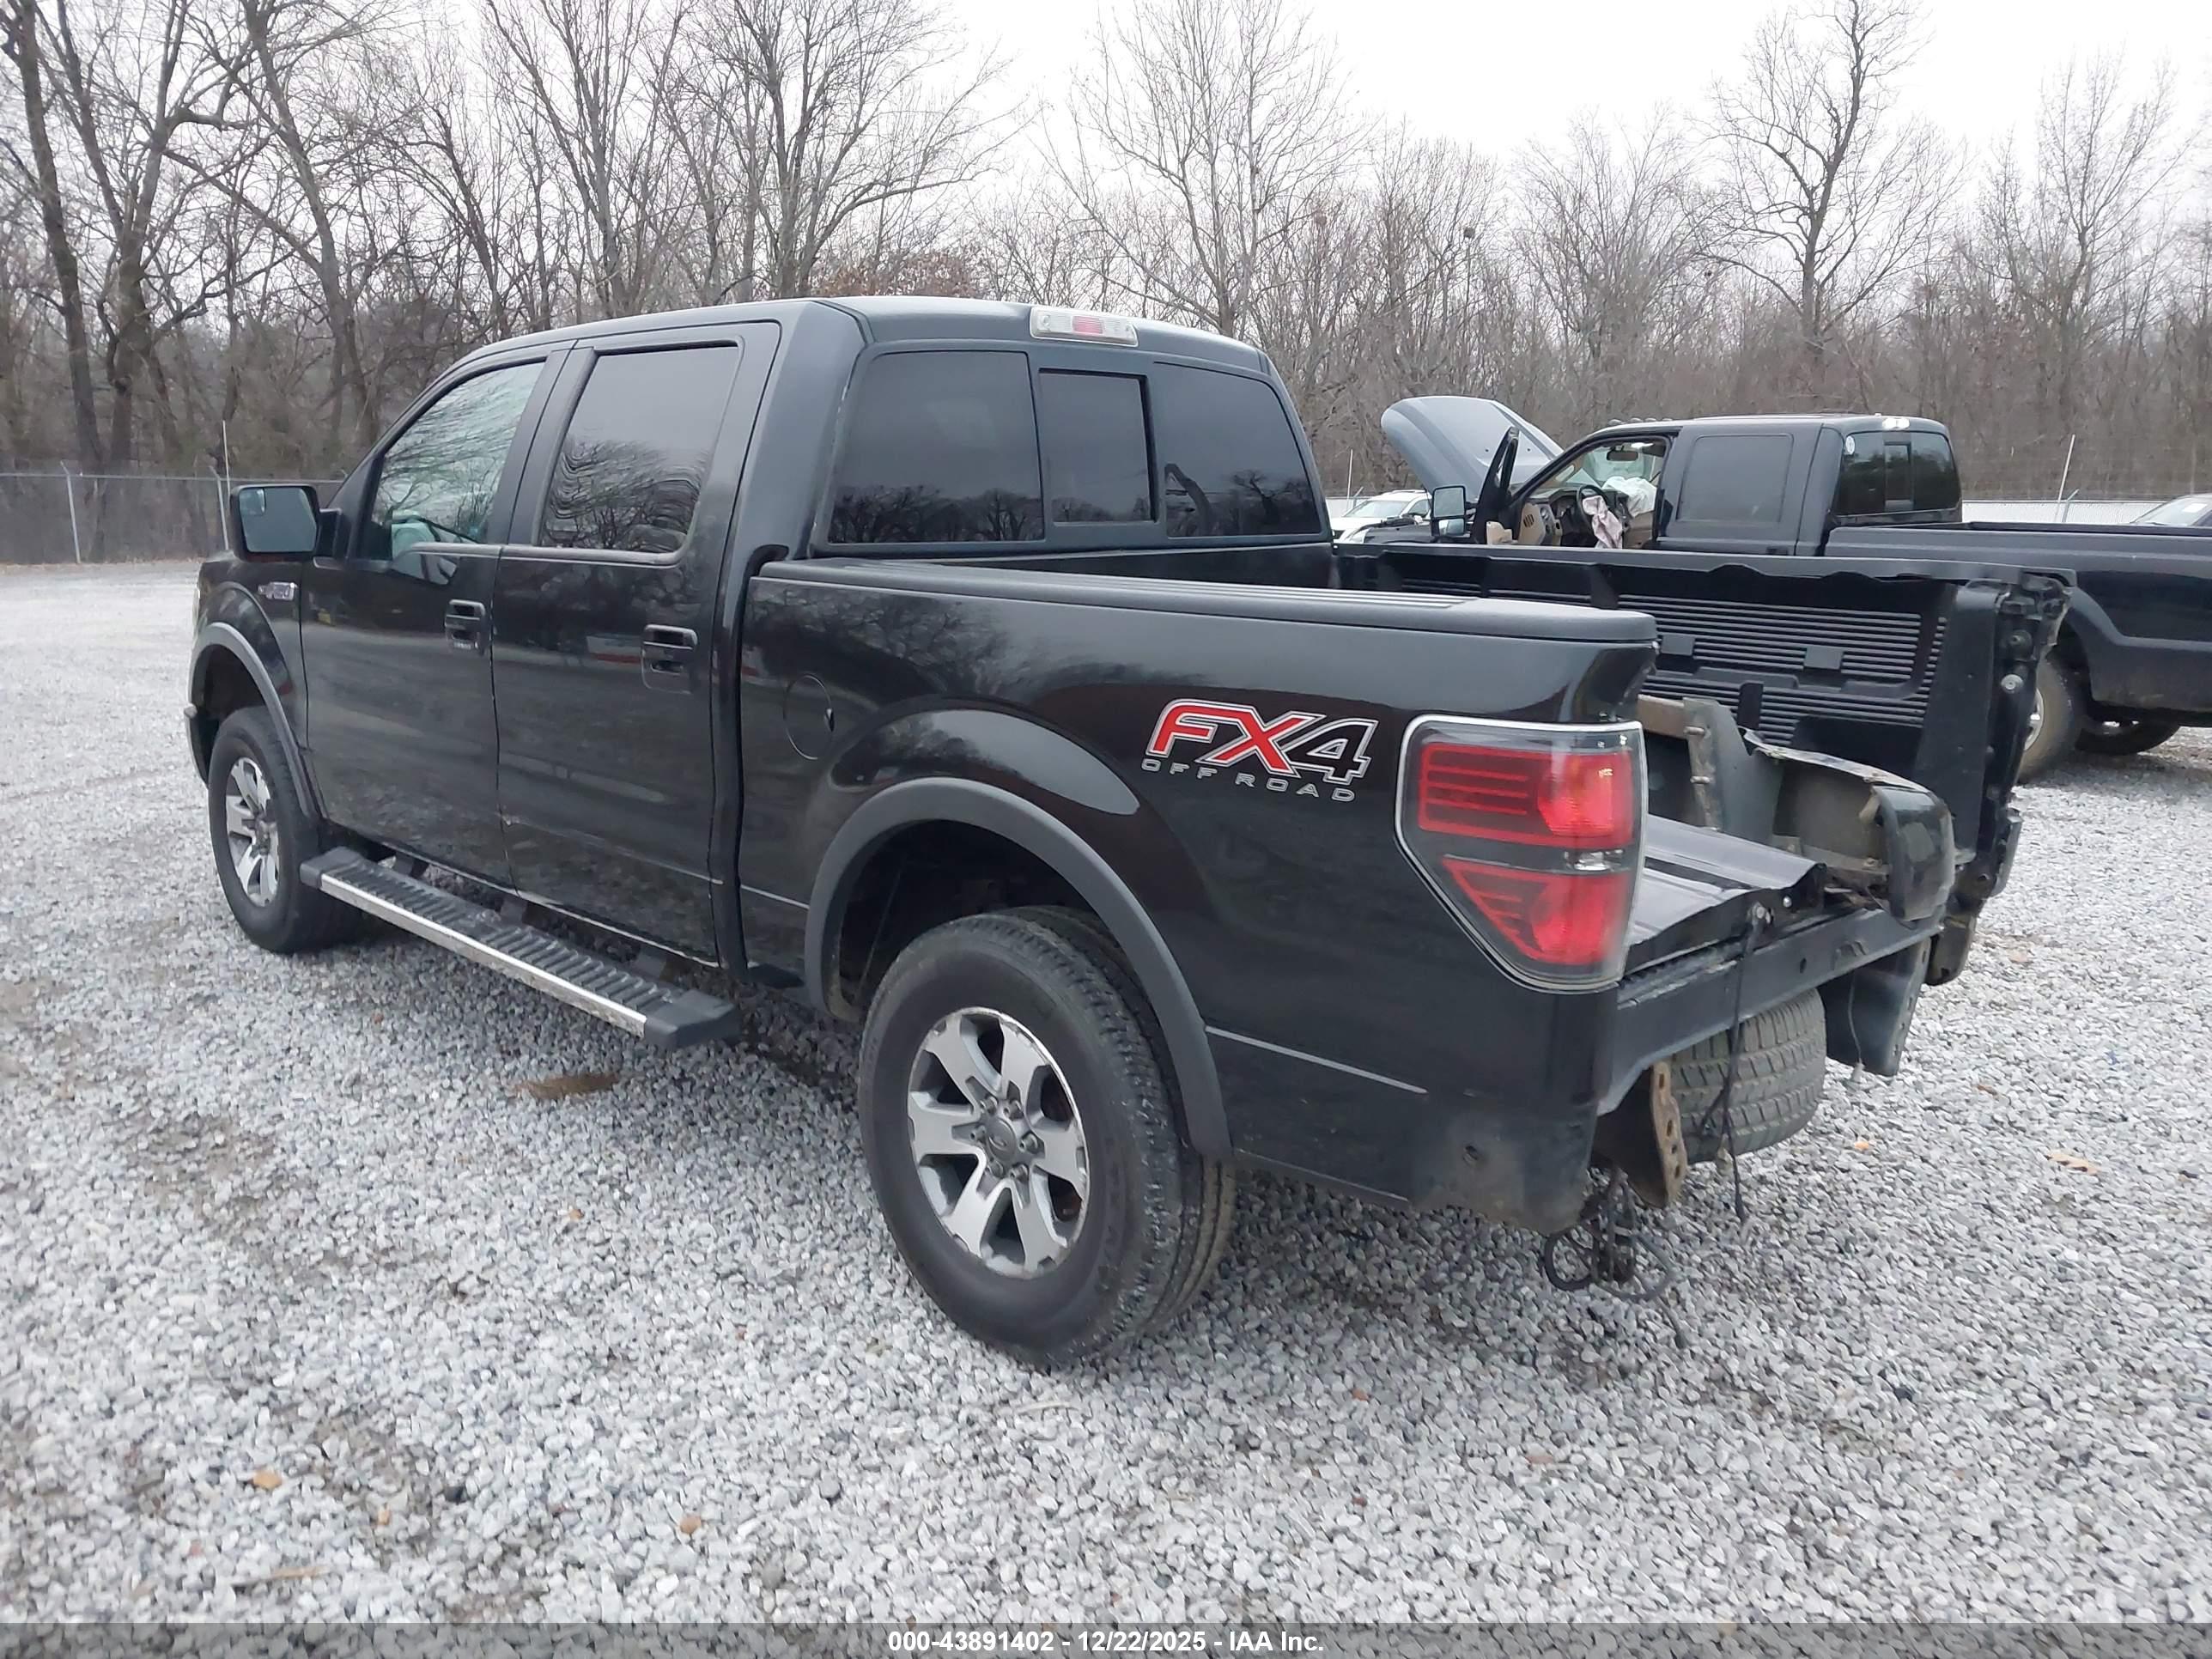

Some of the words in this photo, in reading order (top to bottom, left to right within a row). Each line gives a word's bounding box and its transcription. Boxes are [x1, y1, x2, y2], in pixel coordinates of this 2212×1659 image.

[1146, 698, 1379, 785] FX4
[1141, 757, 1218, 780] OFF
[1235, 773, 1355, 802] ROAD
